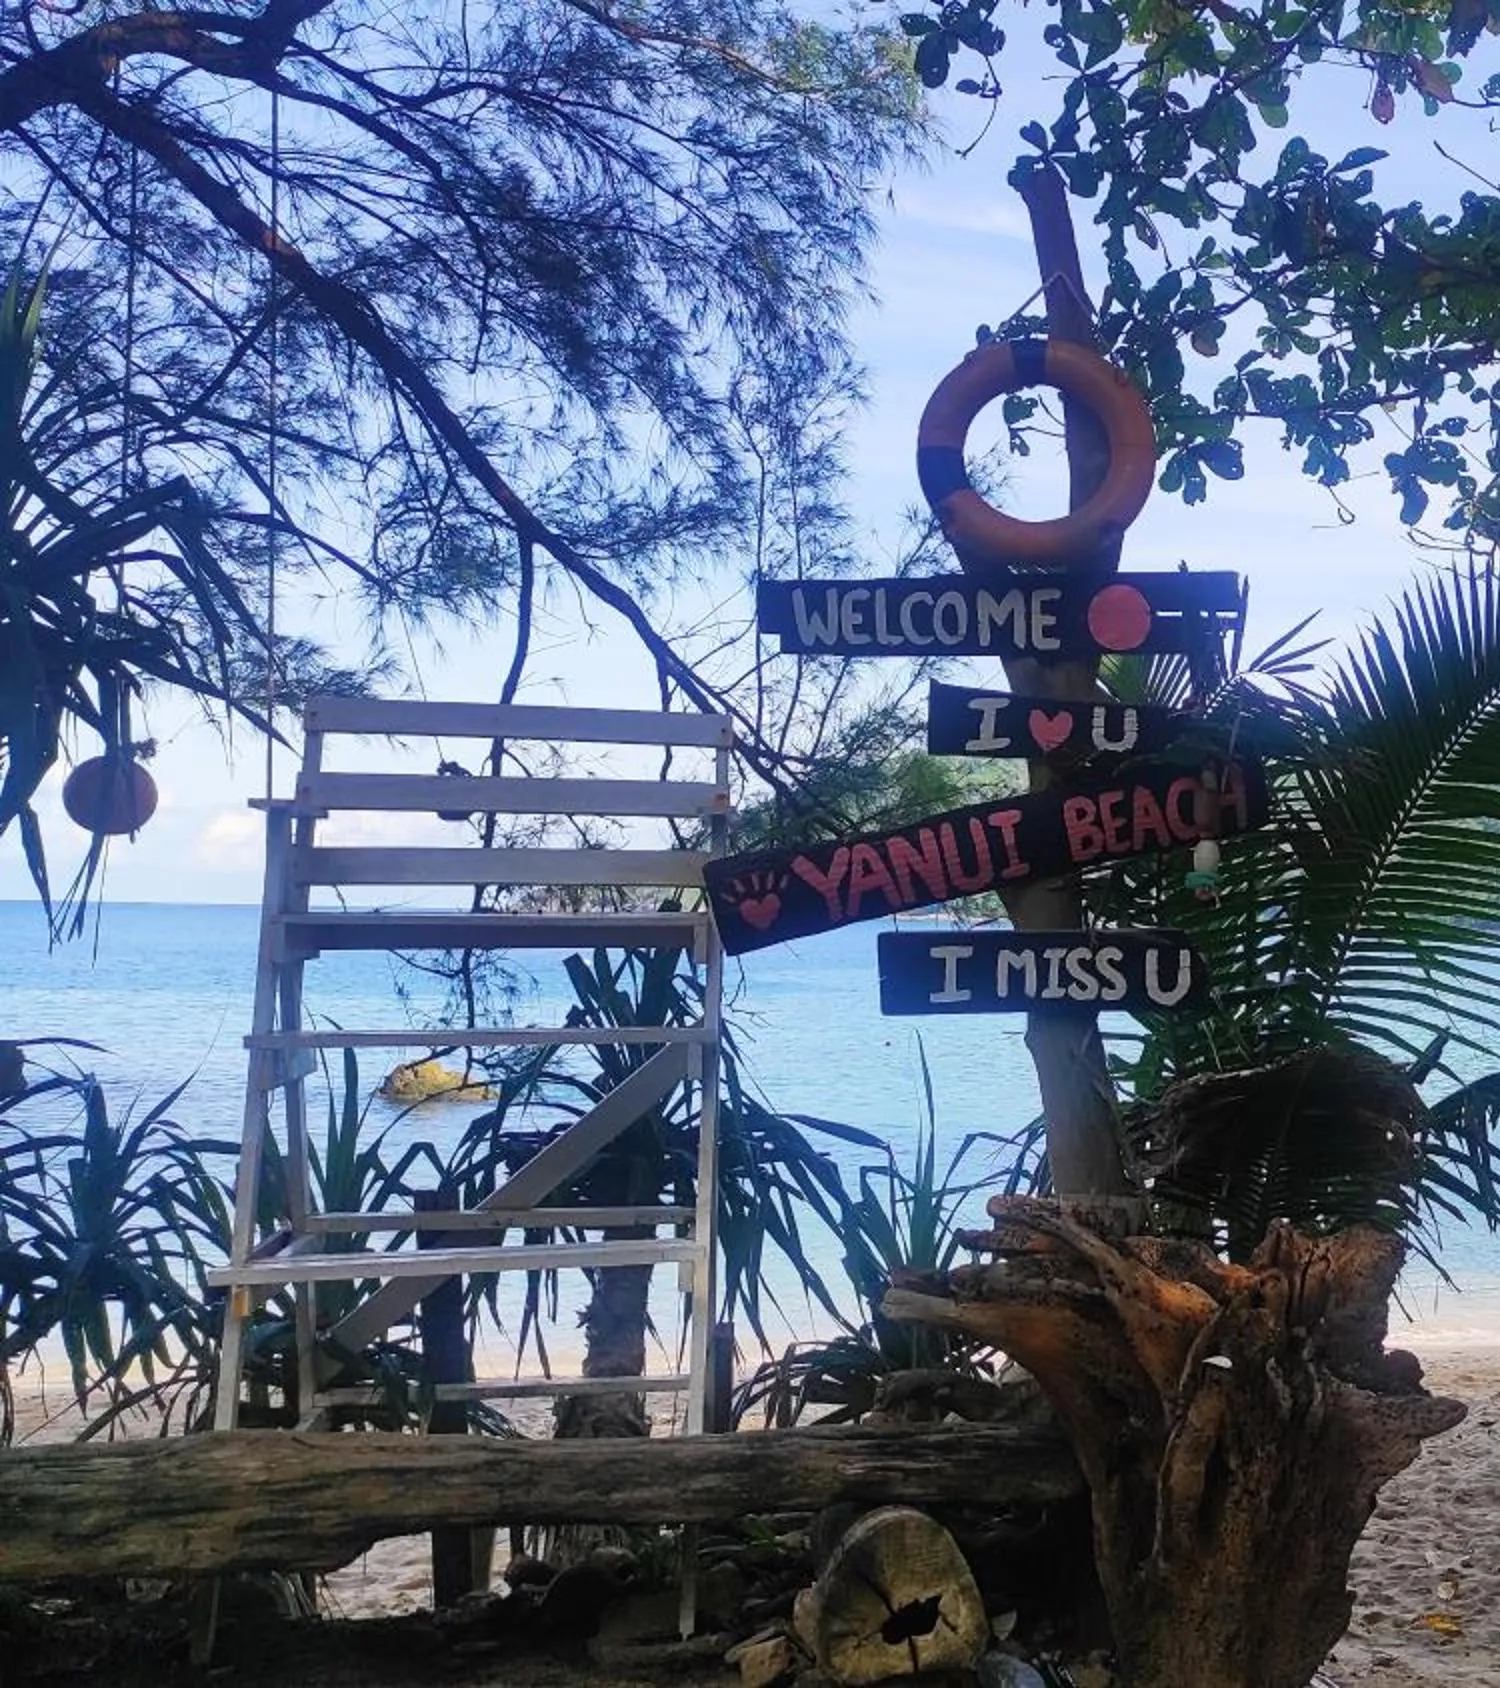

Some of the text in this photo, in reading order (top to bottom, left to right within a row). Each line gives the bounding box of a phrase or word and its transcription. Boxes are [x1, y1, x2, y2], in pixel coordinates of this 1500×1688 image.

[792, 587, 1062, 650] WELCOME
[965, 698, 1137, 753] I U
[791, 809, 1030, 922] YANUI
[929, 946, 1192, 1006] I MISS U
